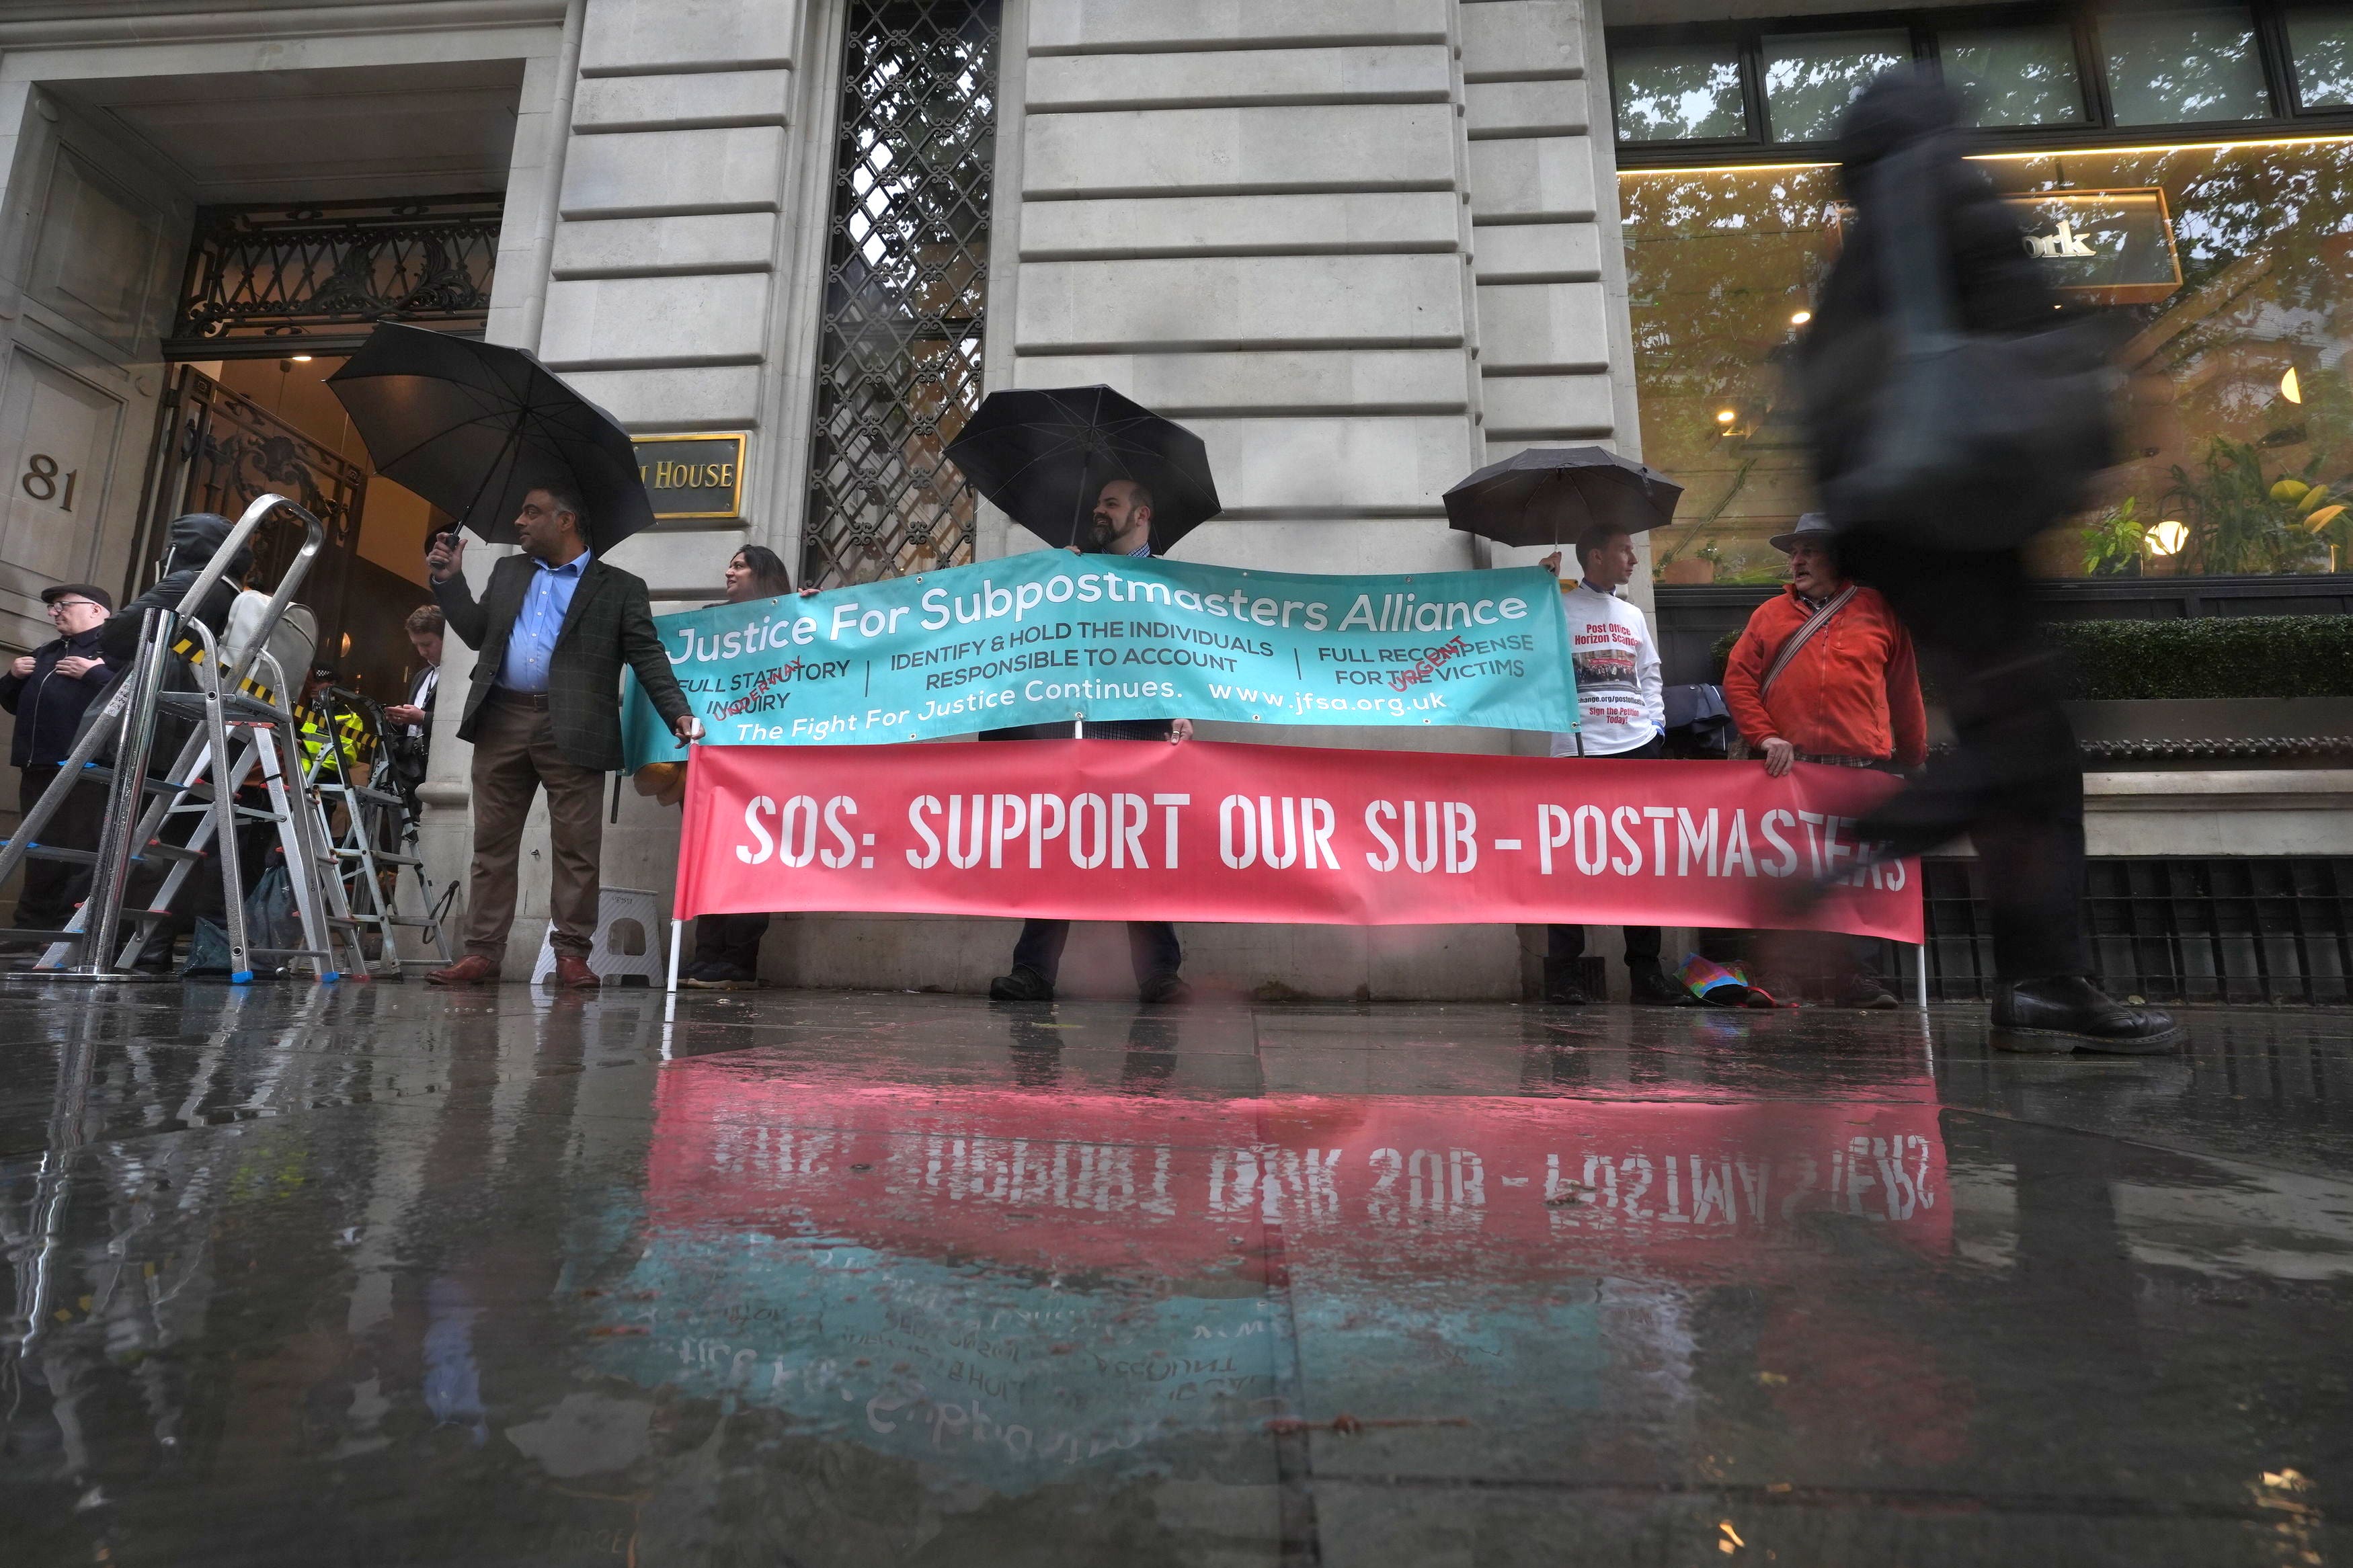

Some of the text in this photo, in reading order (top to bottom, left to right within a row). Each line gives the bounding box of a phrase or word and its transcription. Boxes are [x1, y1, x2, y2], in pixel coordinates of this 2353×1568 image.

[2022, 220, 2097, 258] ork
[23, 454, 77, 512] 81
[653, 461, 733, 489] HOUSE
[665, 572, 1528, 665] Justice For Subpostmasters Alliance
[1587, 623, 1631, 635] Post Office
[891, 621, 1273, 671] IDENTIFY & HOLD THE INDIVIDUALS
[1318, 634, 1533, 663] FULL RECOMPENSE
[1574, 634, 1609, 645] Horizon
[678, 659, 850, 693] FULL STATUTORY
[926, 648, 1237, 690] RESPONSIBLE TO ACCOUNT
[1334, 670, 1383, 684] FOR
[1435, 659, 1524, 682] VICTIMS
[1388, 635, 1468, 692] URGENT
[707, 692, 791, 715] INQUIRY
[737, 723, 783, 741] The
[791, 714, 857, 741] Fight
[865, 708, 910, 729] For
[918, 690, 1015, 720] Justice
[1025, 678, 1183, 702] Continues.
[1589, 707, 1639, 716] Sign the Petition
[1607, 716, 1628, 725] Today!
[736, 795, 875, 870] SOS:
[906, 792, 1191, 870] SUPPORT
[1220, 794, 1341, 870] OUR
[1365, 800, 1478, 873] SUB
